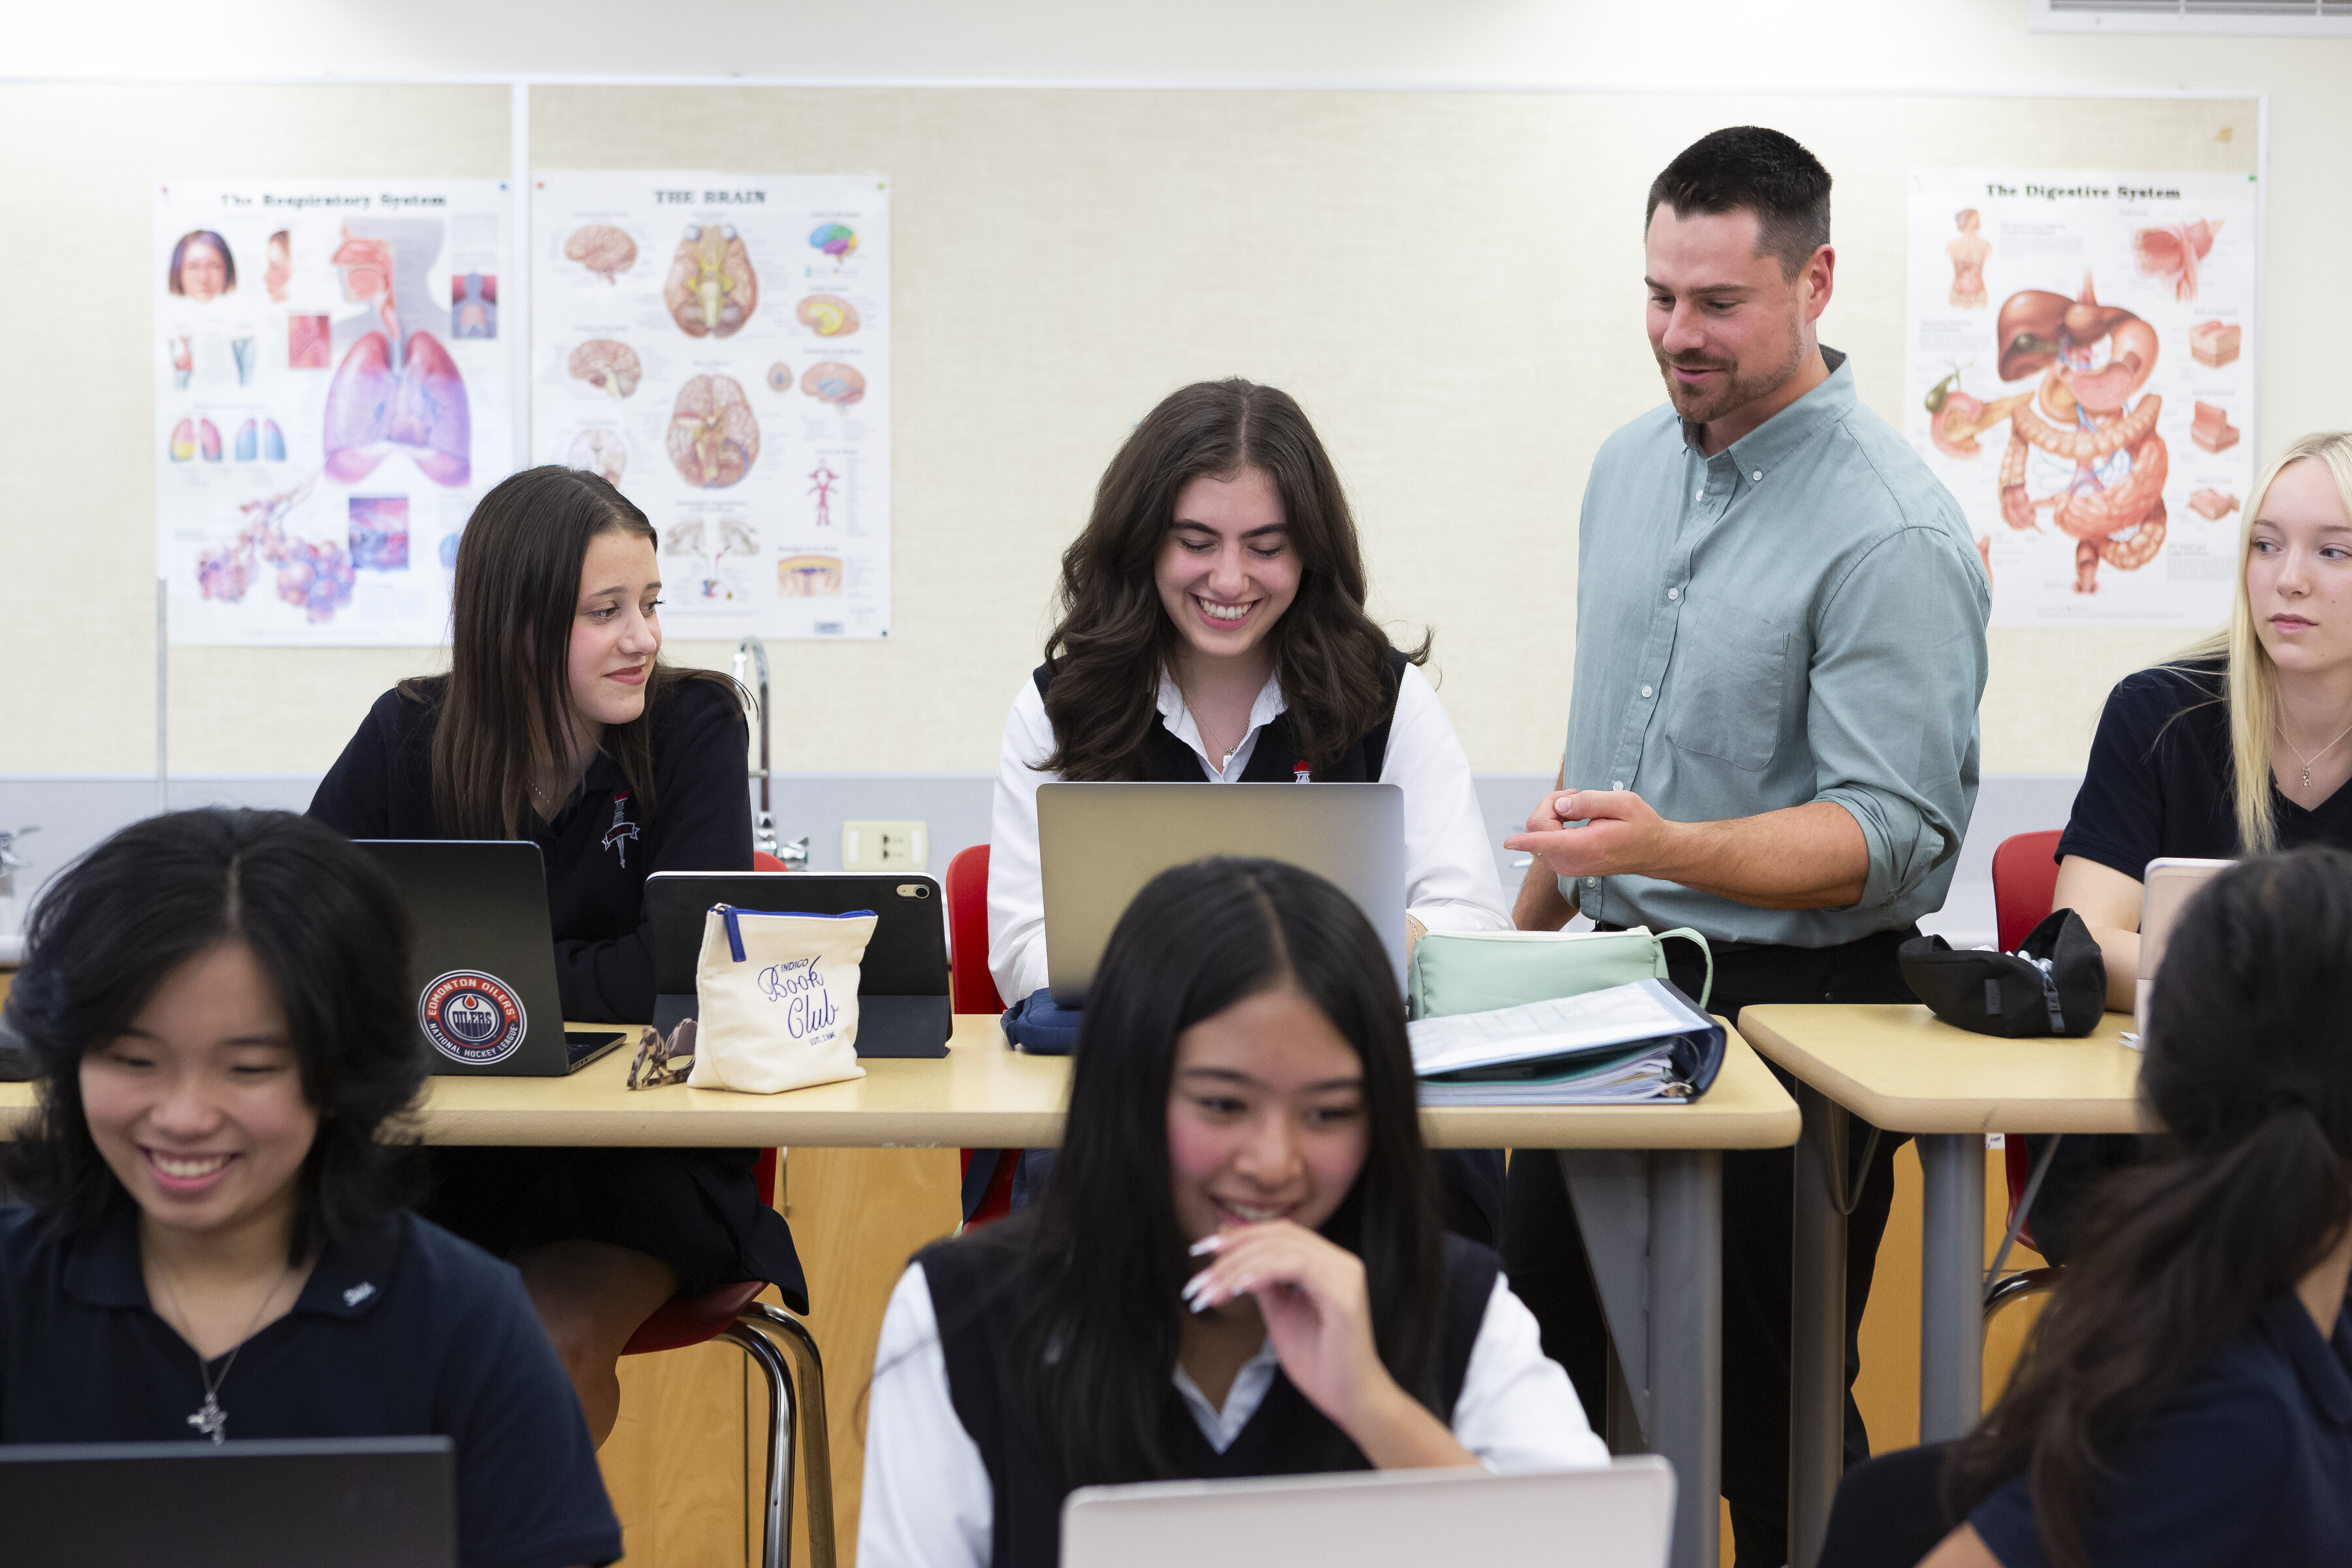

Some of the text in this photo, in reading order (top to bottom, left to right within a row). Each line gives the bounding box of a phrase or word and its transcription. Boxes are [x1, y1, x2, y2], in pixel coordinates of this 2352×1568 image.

[221, 195, 447, 210] The Respiratory System
[655, 191, 766, 204] THE BRAIN
[1987, 185, 2180, 203] The Digestive System
[758, 955, 824, 1002] Book
[781, 958, 809, 973] INDIGO
[428, 979, 515, 1016] EDMONTON OILERS
[788, 988, 839, 1038] Club
[429, 1023, 518, 1058] NATIONAL HOCKEY LEAGUE
